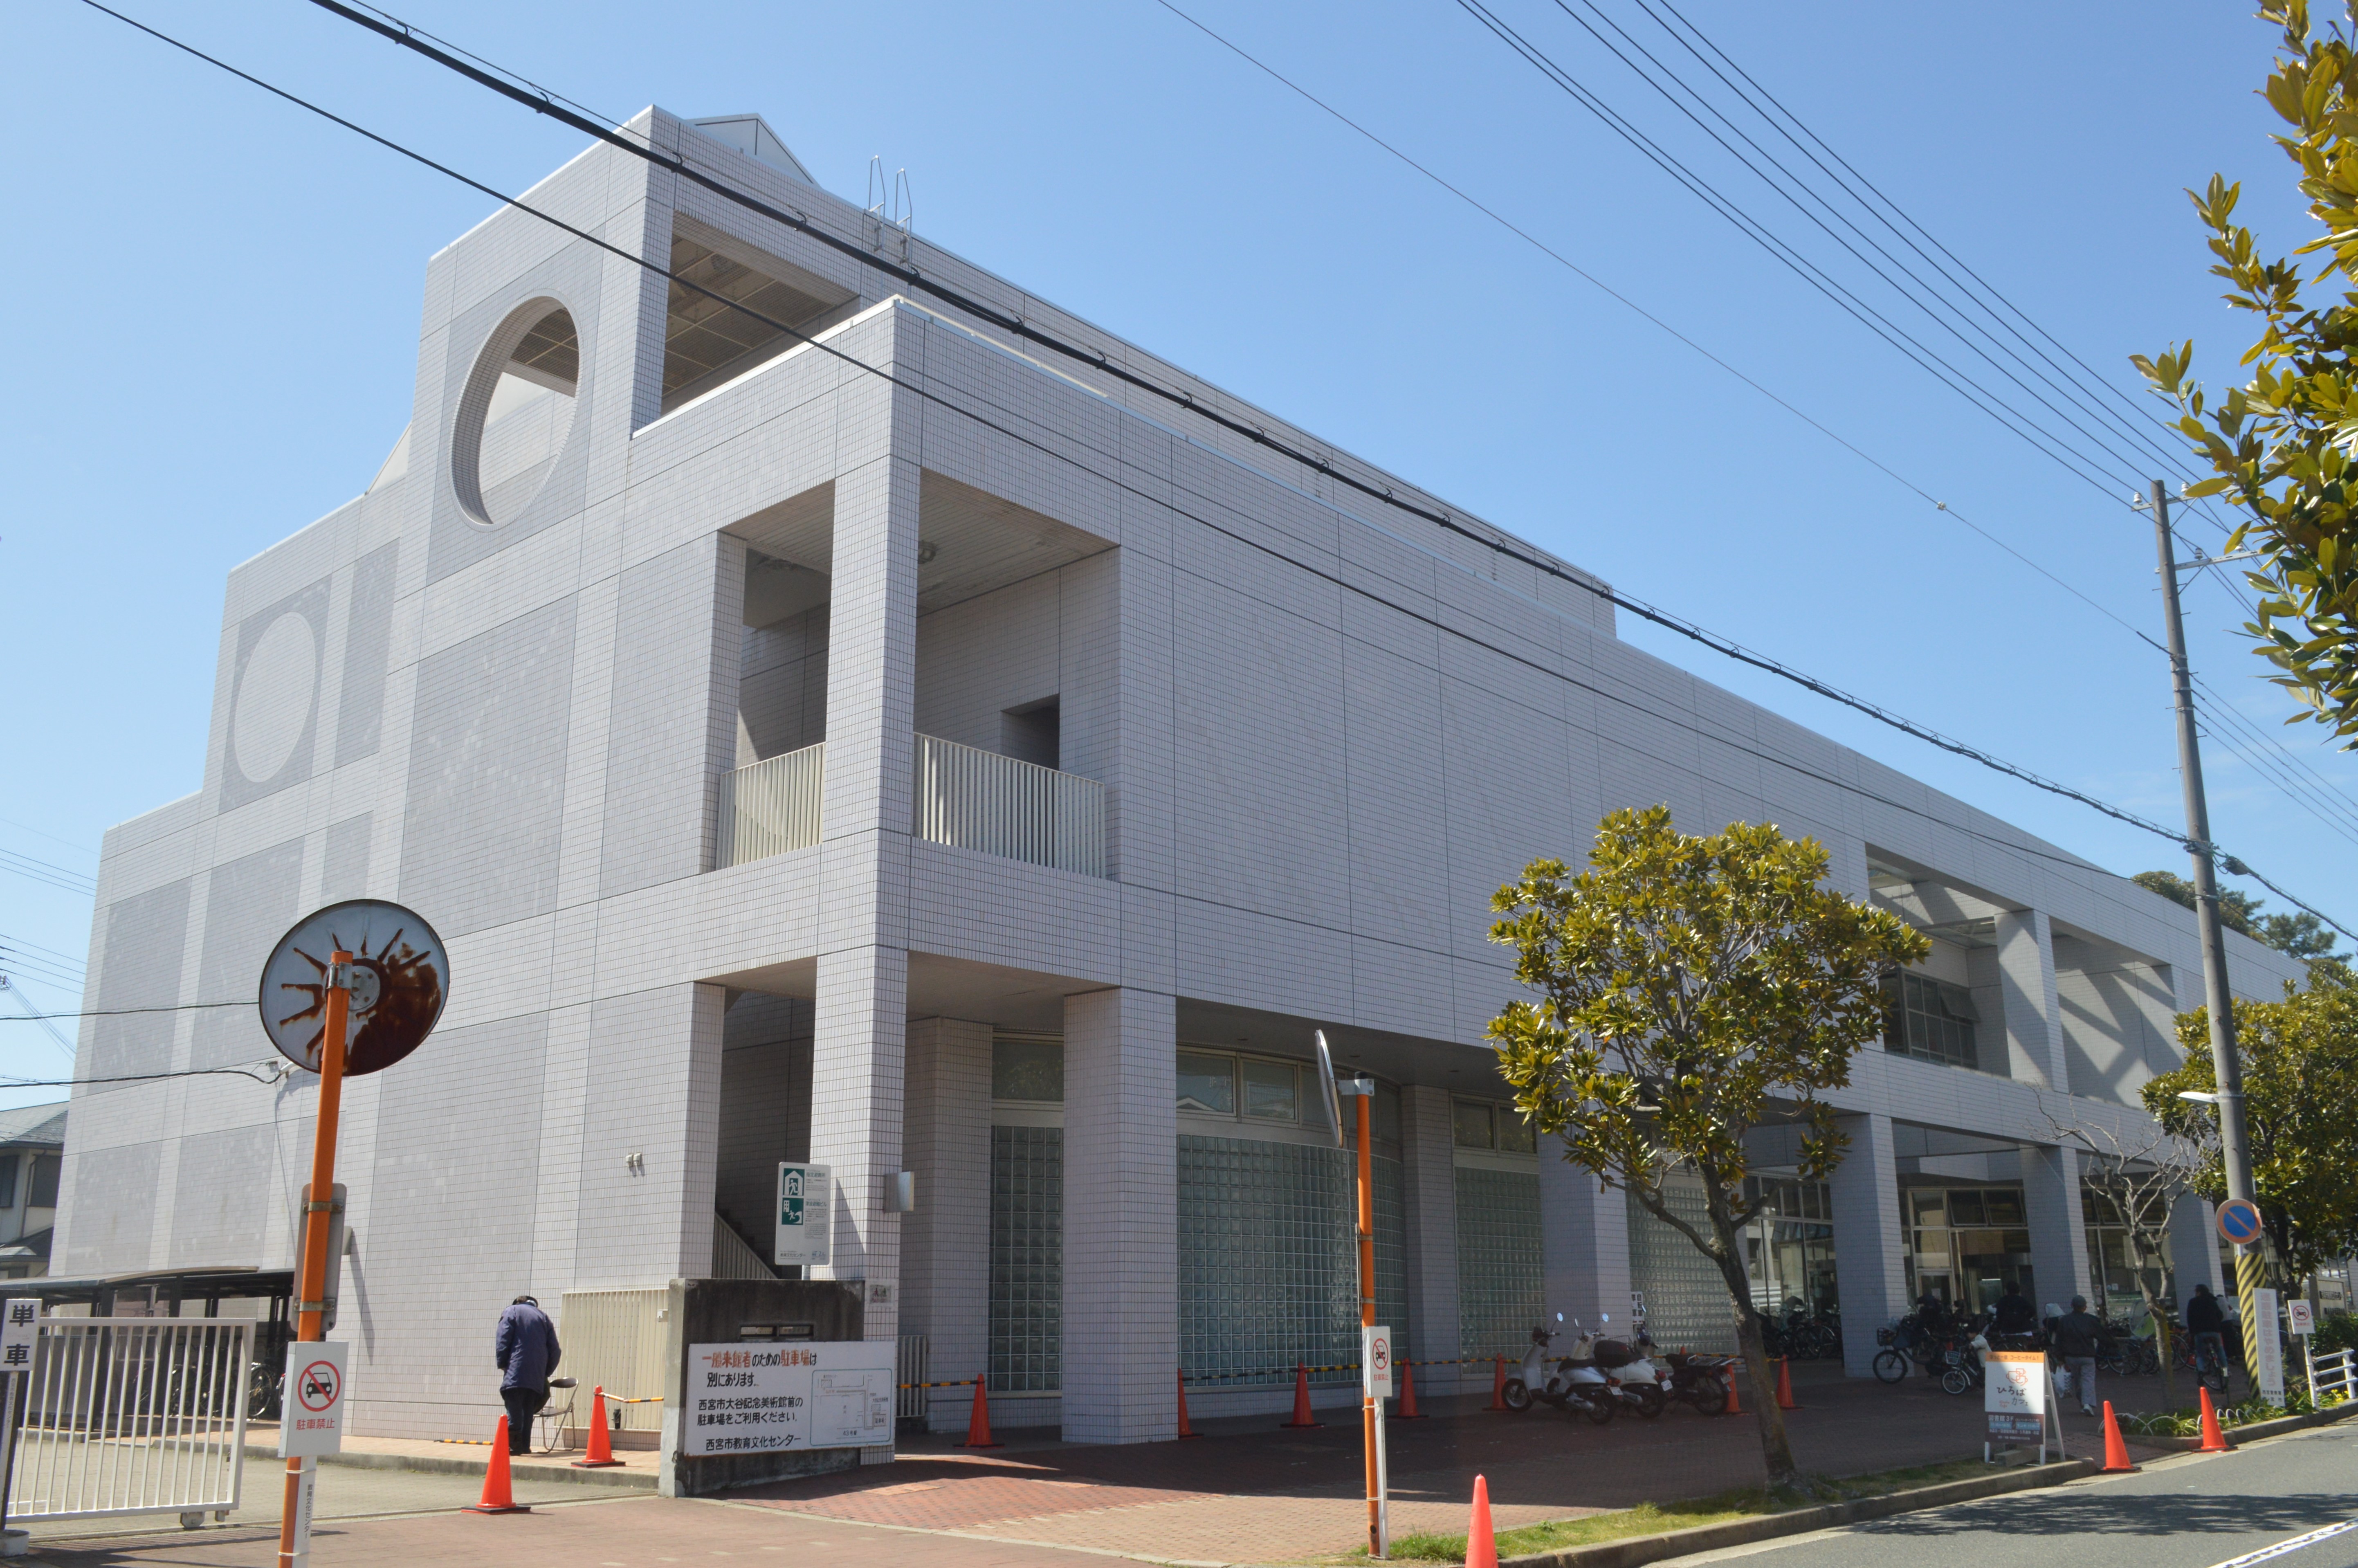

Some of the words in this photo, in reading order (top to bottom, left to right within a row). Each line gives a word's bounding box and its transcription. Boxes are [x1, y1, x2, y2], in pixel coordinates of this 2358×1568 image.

[4, 1304, 35, 1366] 単車
[702, 1348, 817, 1368] 一般来館者のための駐車場は
[1996, 1386, 2026, 1396] ひろば
[698, 1395, 803, 1411] 西宮市大谷記念美術館前の
[2011, 1396, 2028, 1406] カフェ
[296, 1417, 335, 1430] 駐車禁止
[706, 1434, 802, 1451] 西宮市教育文化センター
[304, 1484, 313, 1539] 教育文化センター
